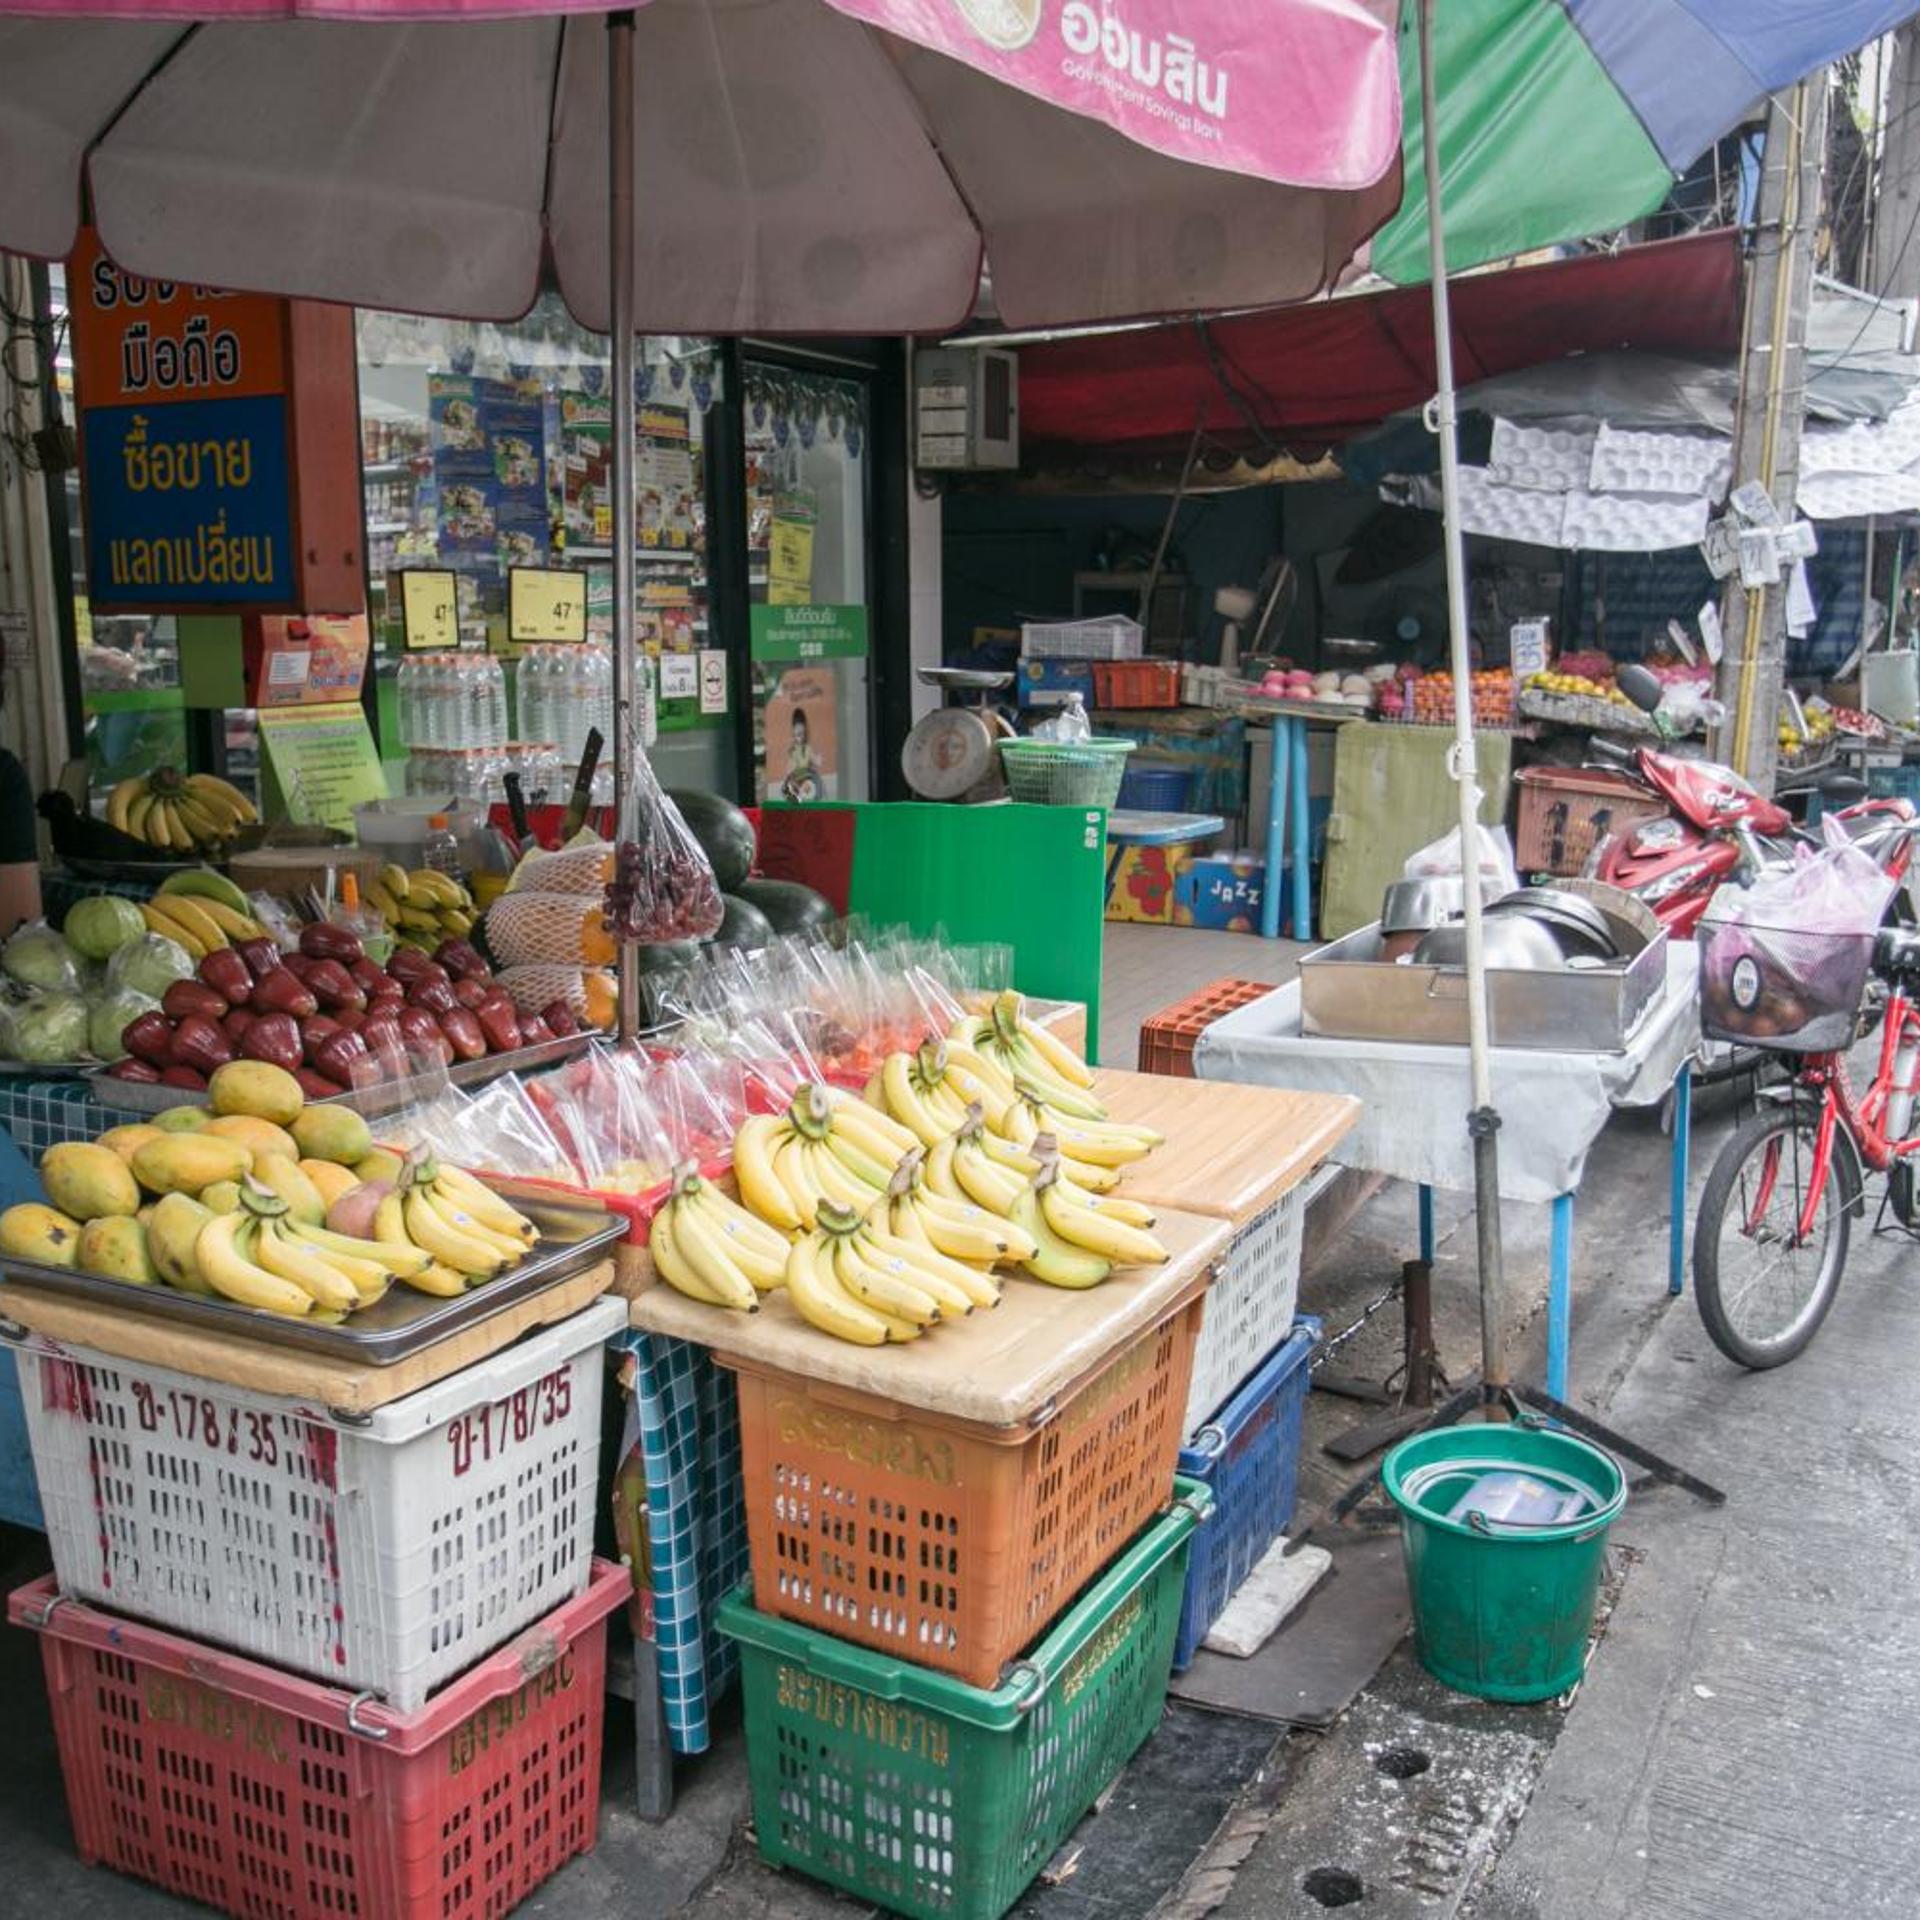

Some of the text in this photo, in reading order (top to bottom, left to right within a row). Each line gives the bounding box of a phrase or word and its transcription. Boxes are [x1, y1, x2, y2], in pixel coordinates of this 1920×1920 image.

[1146, 99, 1192, 132] Savings
[121, 315, 240, 391] มือถือ
[123, 414, 252, 492] ซื้อขาย
[110, 507, 274, 585] แลกเปลี่ยน
[552, 602, 572, 619] 47
[1211, 879, 1262, 906] JAZZ
